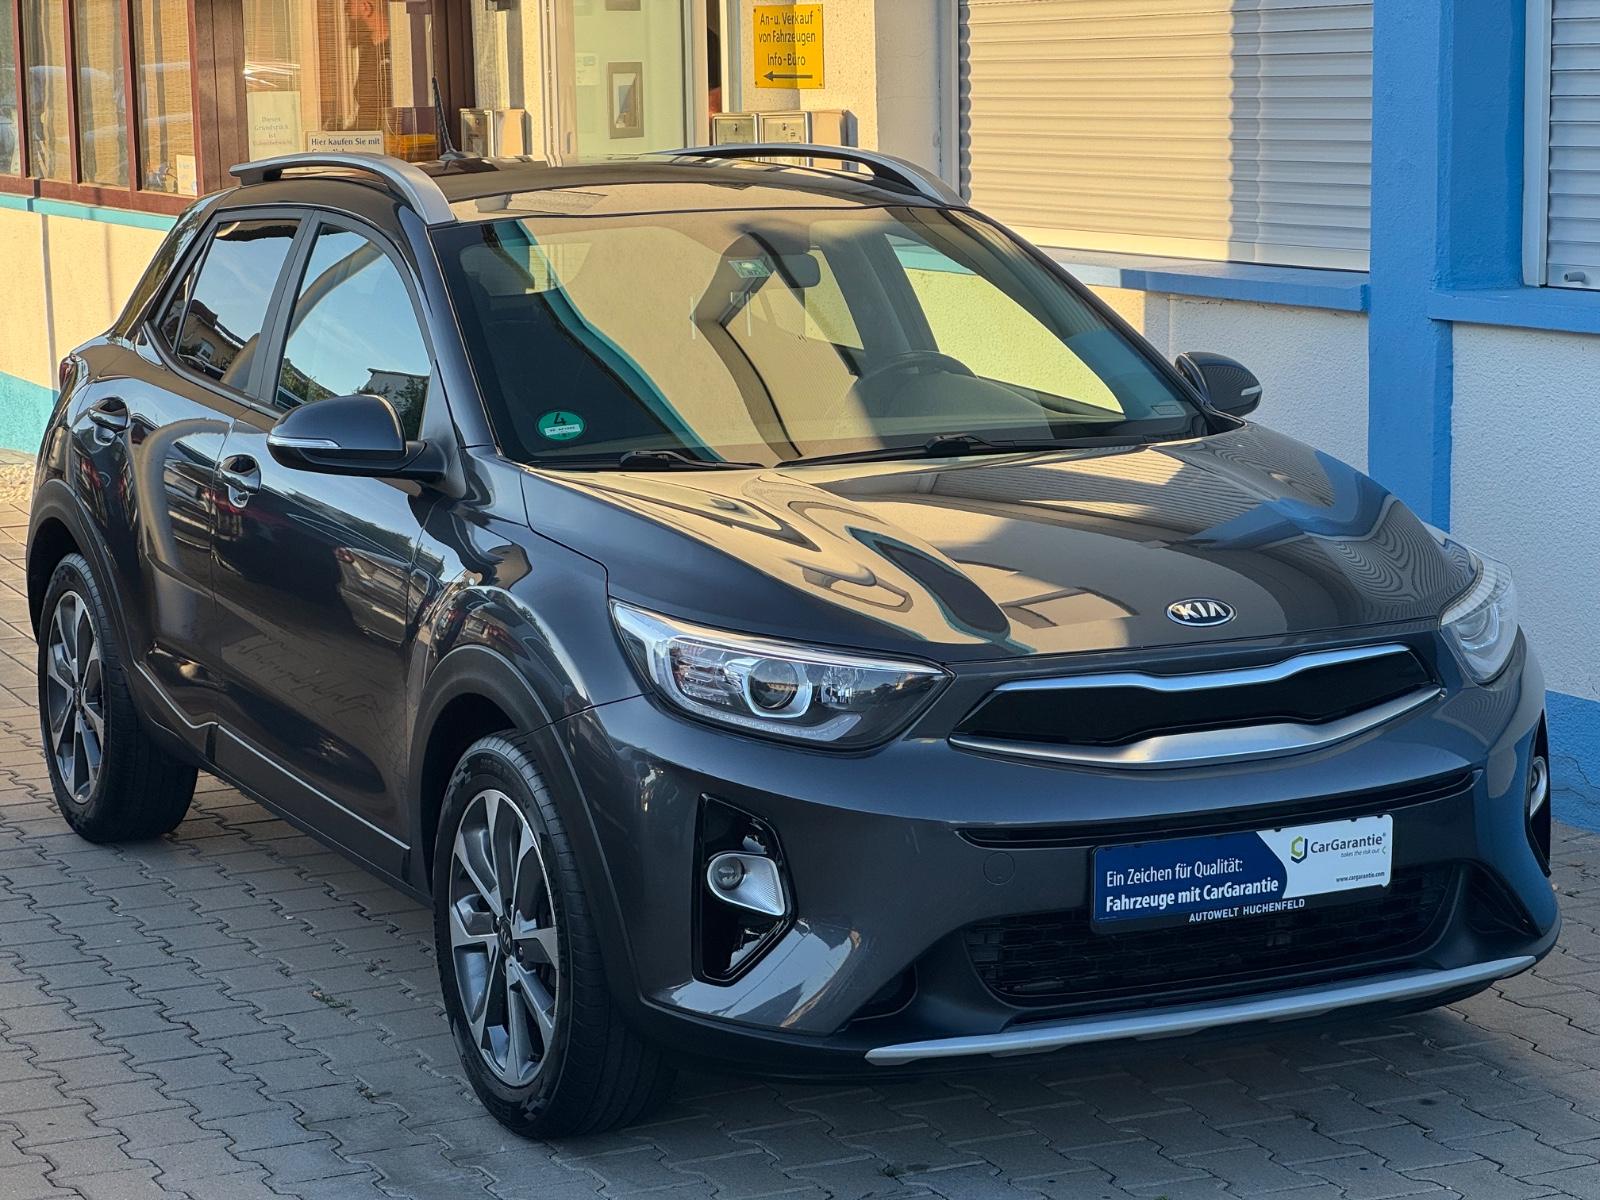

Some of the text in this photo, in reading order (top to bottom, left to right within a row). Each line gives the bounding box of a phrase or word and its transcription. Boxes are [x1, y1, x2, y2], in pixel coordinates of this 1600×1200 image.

[782, 11, 813, 25] Verkauf
[759, 29, 816, 46] von Fahrzeugen
[328, 138, 353, 146] kaufen
[354, 137, 367, 145] Sie
[554, 412, 567, 425] 4
[1171, 601, 1227, 620] KIA
[1106, 858, 1243, 887] Ein Zeichen für Qualität:
[1106, 877, 1279, 912] Fahrzeuge mit CarGarantie
[1188, 898, 1305, 923] AUTOWELT HUCHENFELD
